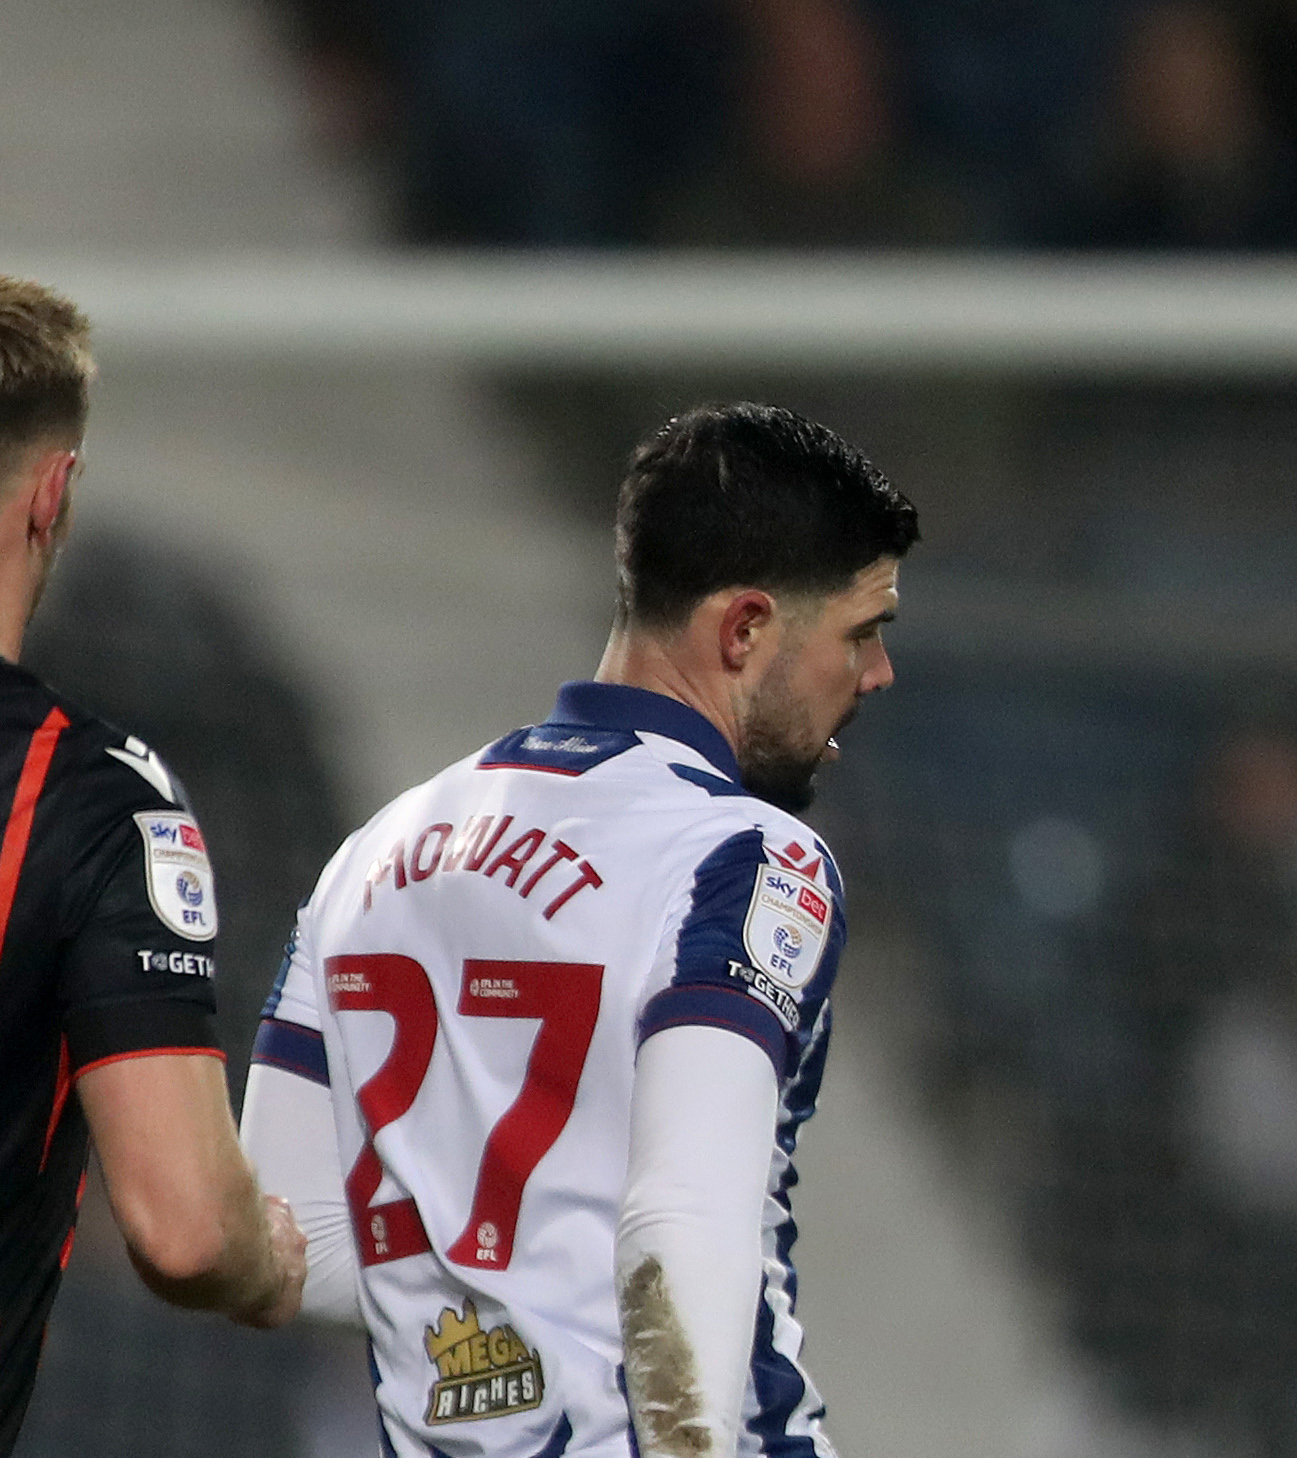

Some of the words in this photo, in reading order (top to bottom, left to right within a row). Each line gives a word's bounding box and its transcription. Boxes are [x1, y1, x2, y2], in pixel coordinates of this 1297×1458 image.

[150, 824, 177, 844] sky
[765, 875, 797, 898] sky
[800, 890, 825, 920] bet
[183, 910, 205, 926] EFL
[770, 954, 793, 979] EFL
[479, 988, 519, 998] COMMUNITY
[323, 952, 605, 1272] 27
[476, 1248, 497, 1261] EFL
[437, 1325, 530, 1378] MEGA
[436, 1370, 535, 1417] RICHES
